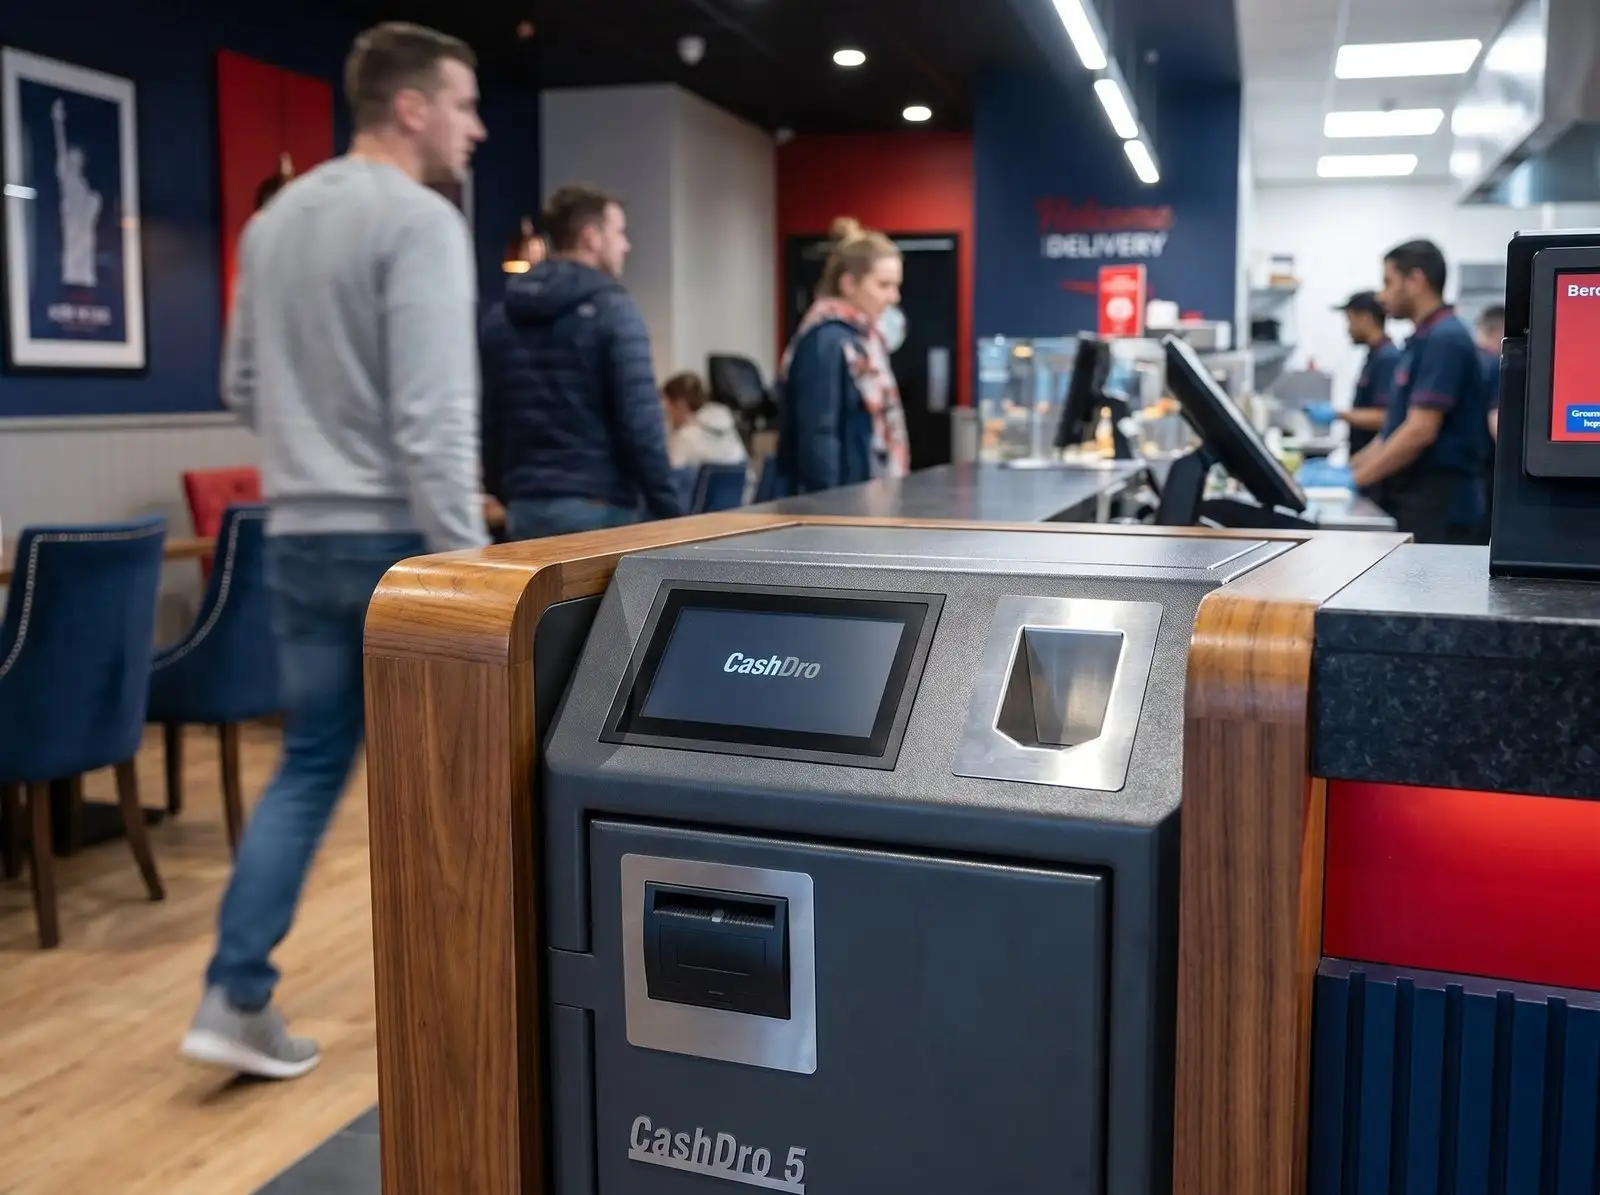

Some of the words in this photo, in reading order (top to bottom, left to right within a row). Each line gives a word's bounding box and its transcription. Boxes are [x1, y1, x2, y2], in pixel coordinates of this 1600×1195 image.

[1045, 232, 1168, 258] DELIVERY
[723, 652, 821, 679] CashDro
[629, 1115, 772, 1178] CashDro
[784, 1146, 807, 1184] 5
